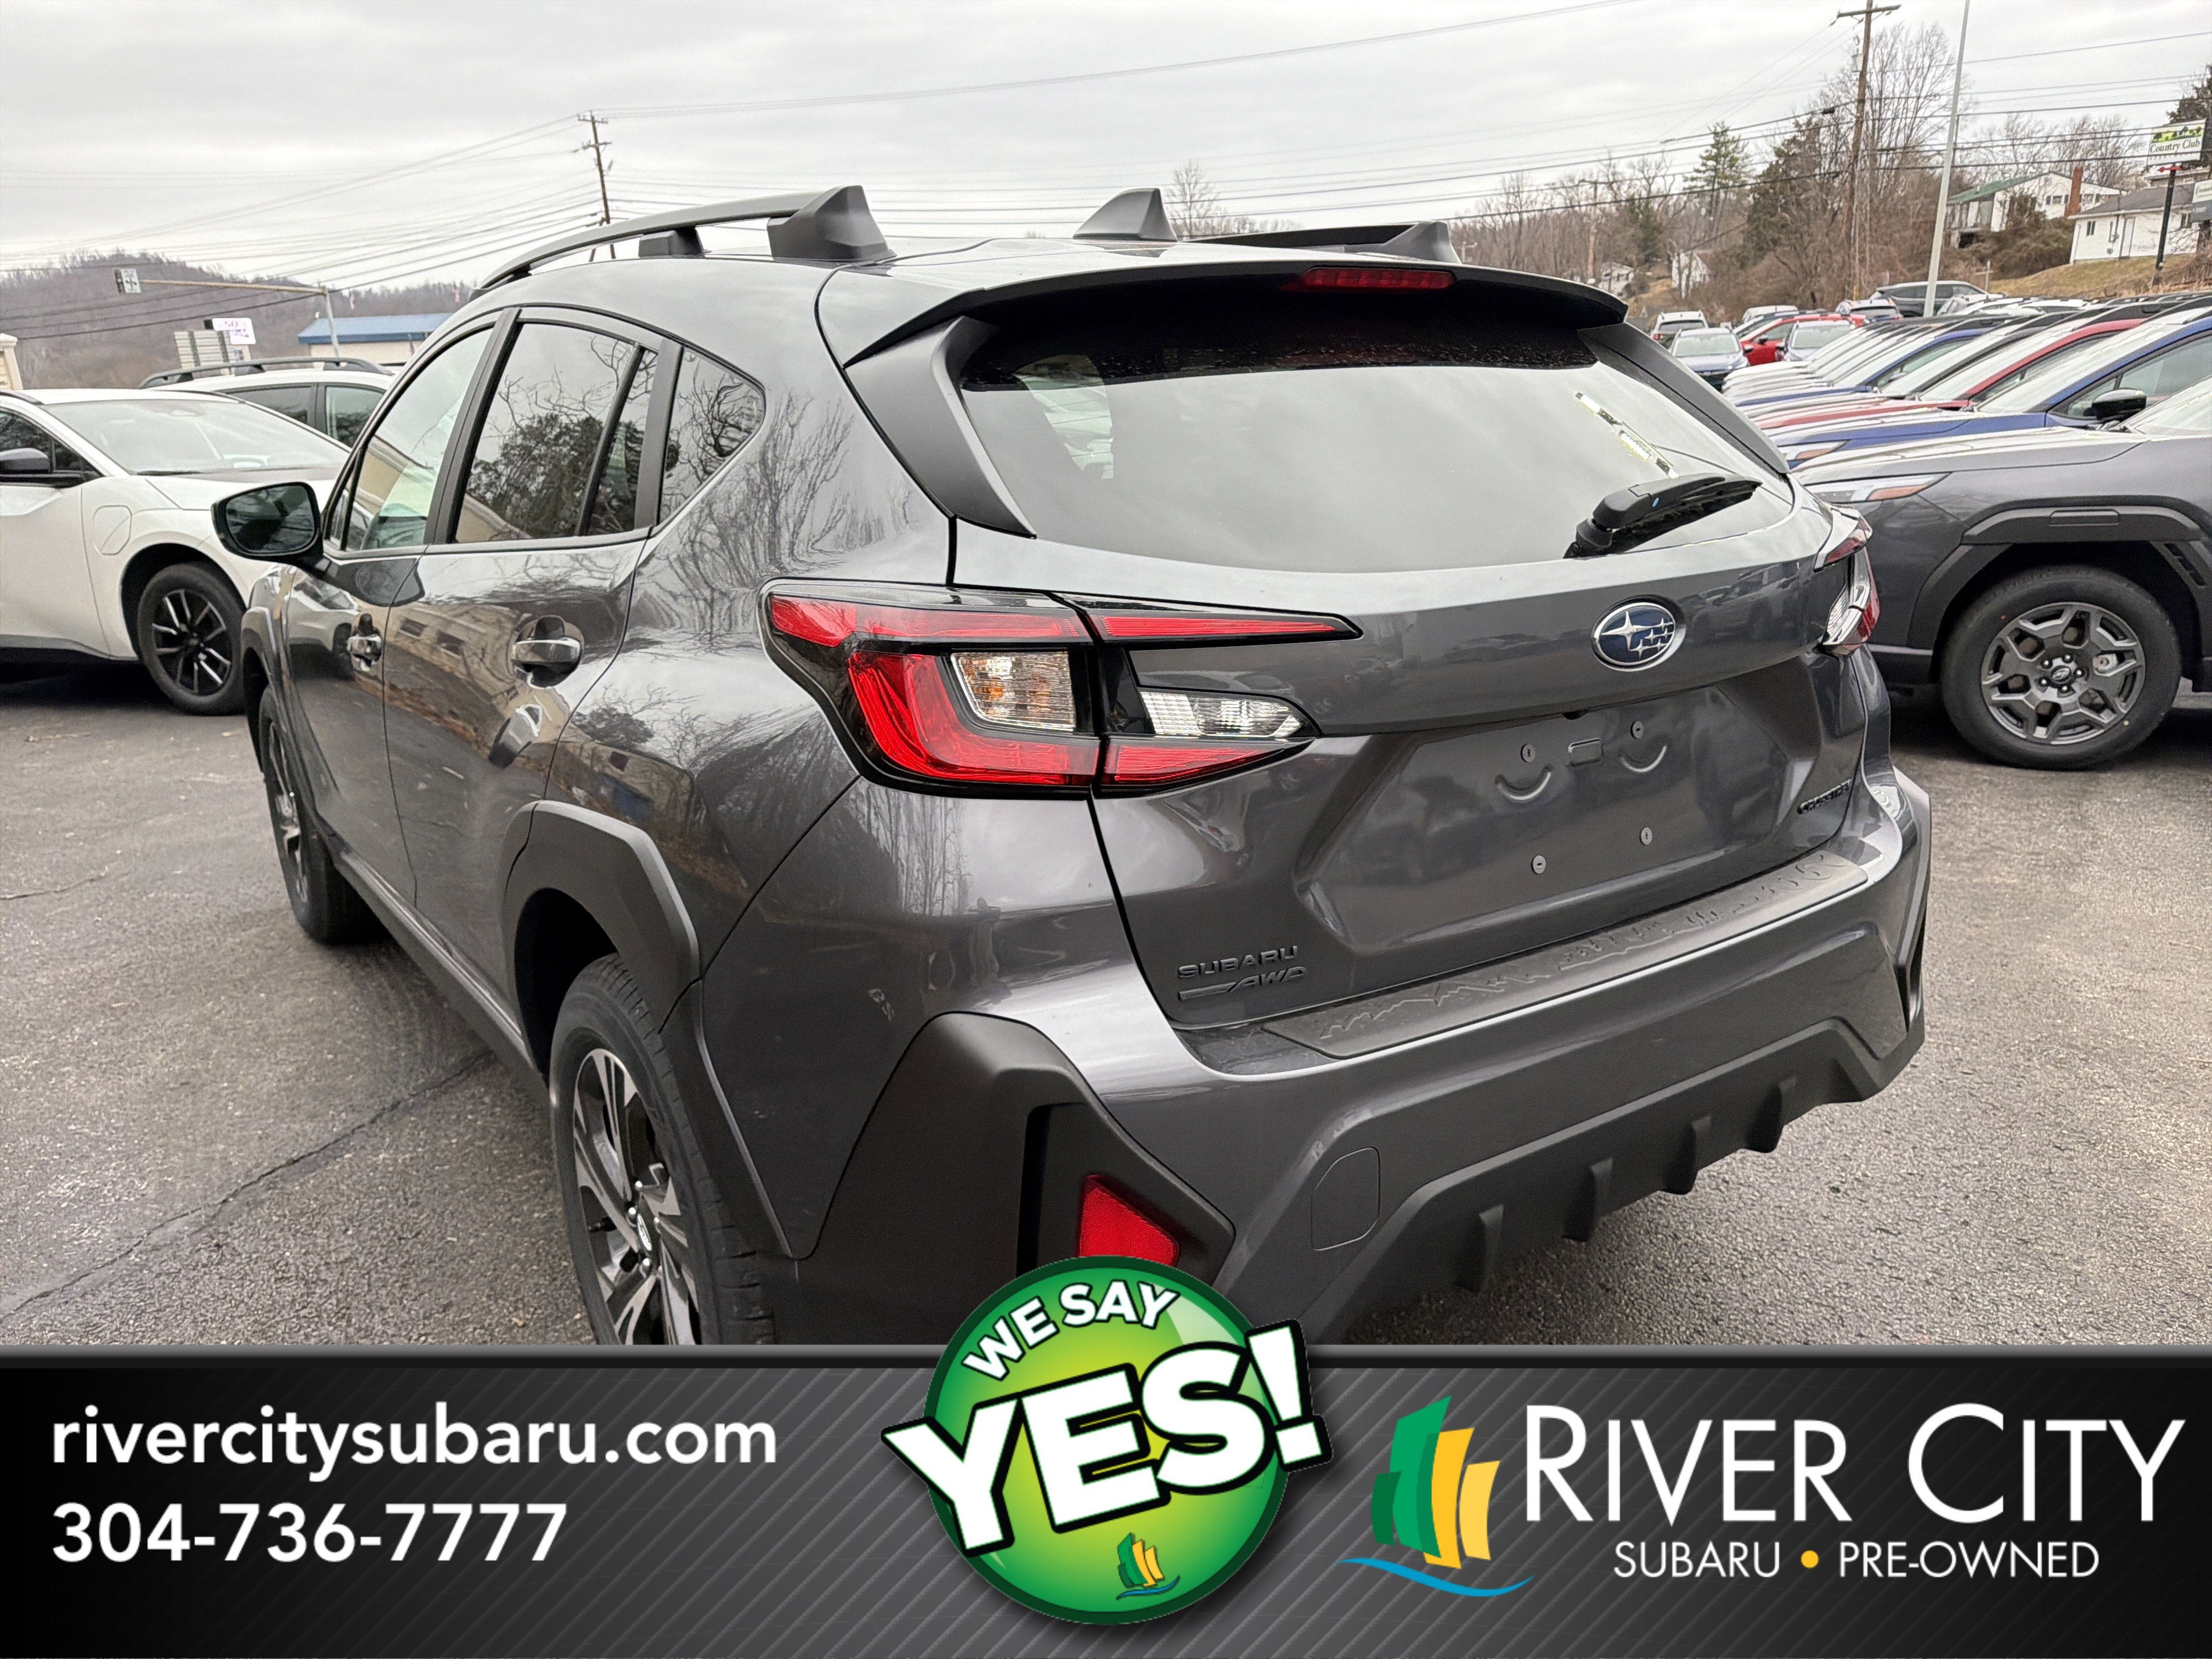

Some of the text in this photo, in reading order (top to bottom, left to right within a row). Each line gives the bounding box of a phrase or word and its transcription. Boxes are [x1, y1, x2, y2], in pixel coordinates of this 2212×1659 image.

[2150, 138, 2200, 153] Country Club
[1178, 945, 1298, 978] SUBARU
[1228, 966, 1307, 992] AWD
